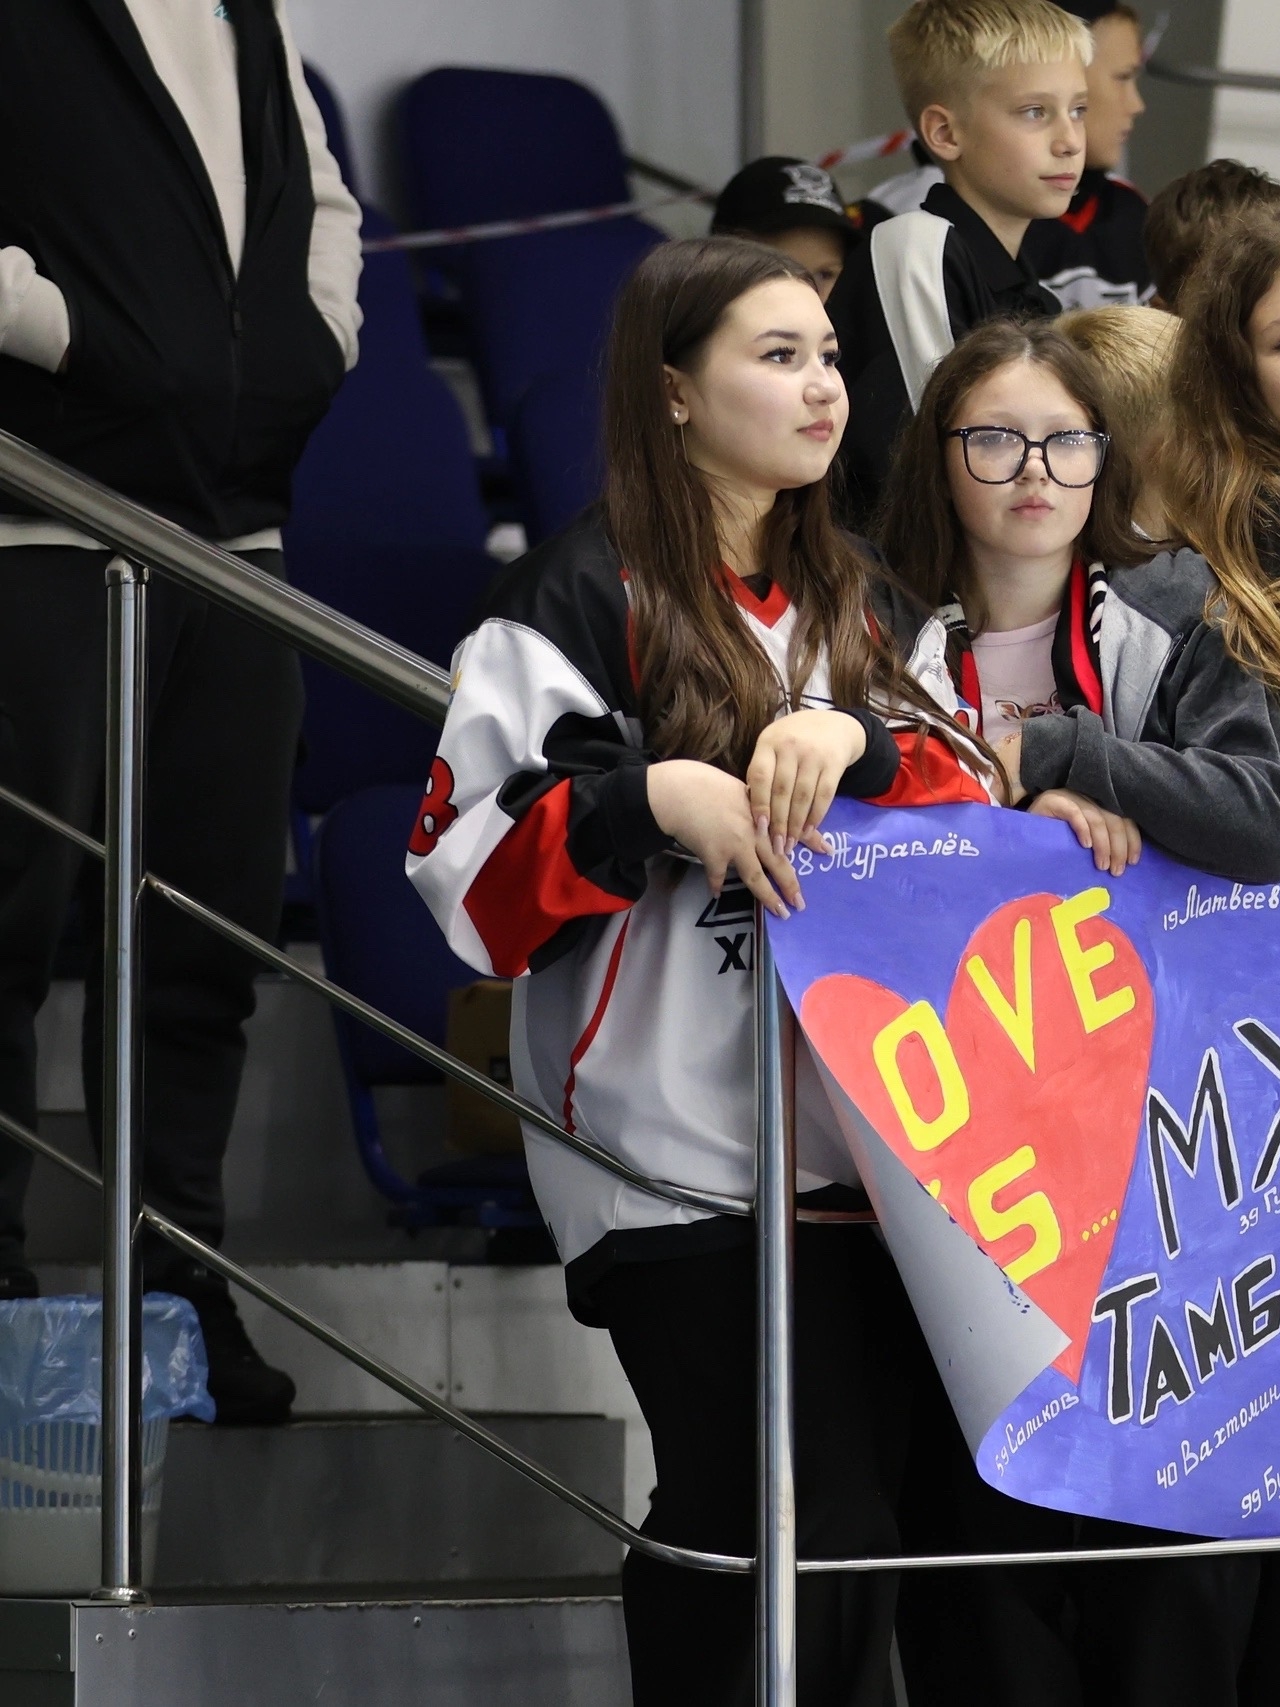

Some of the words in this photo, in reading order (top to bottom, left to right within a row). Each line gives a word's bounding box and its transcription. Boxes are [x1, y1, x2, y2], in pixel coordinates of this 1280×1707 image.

[820, 831, 980, 880] Журавлёв
[1163, 910, 1179, 931] 19
[1179, 882, 1280, 925] Матвеев
[1239, 1206, 1260, 1235] 39
[1005, 1392, 1080, 1454] Саликов
[1156, 1460, 1179, 1490] 40
[1241, 1488, 1262, 1519] 99
